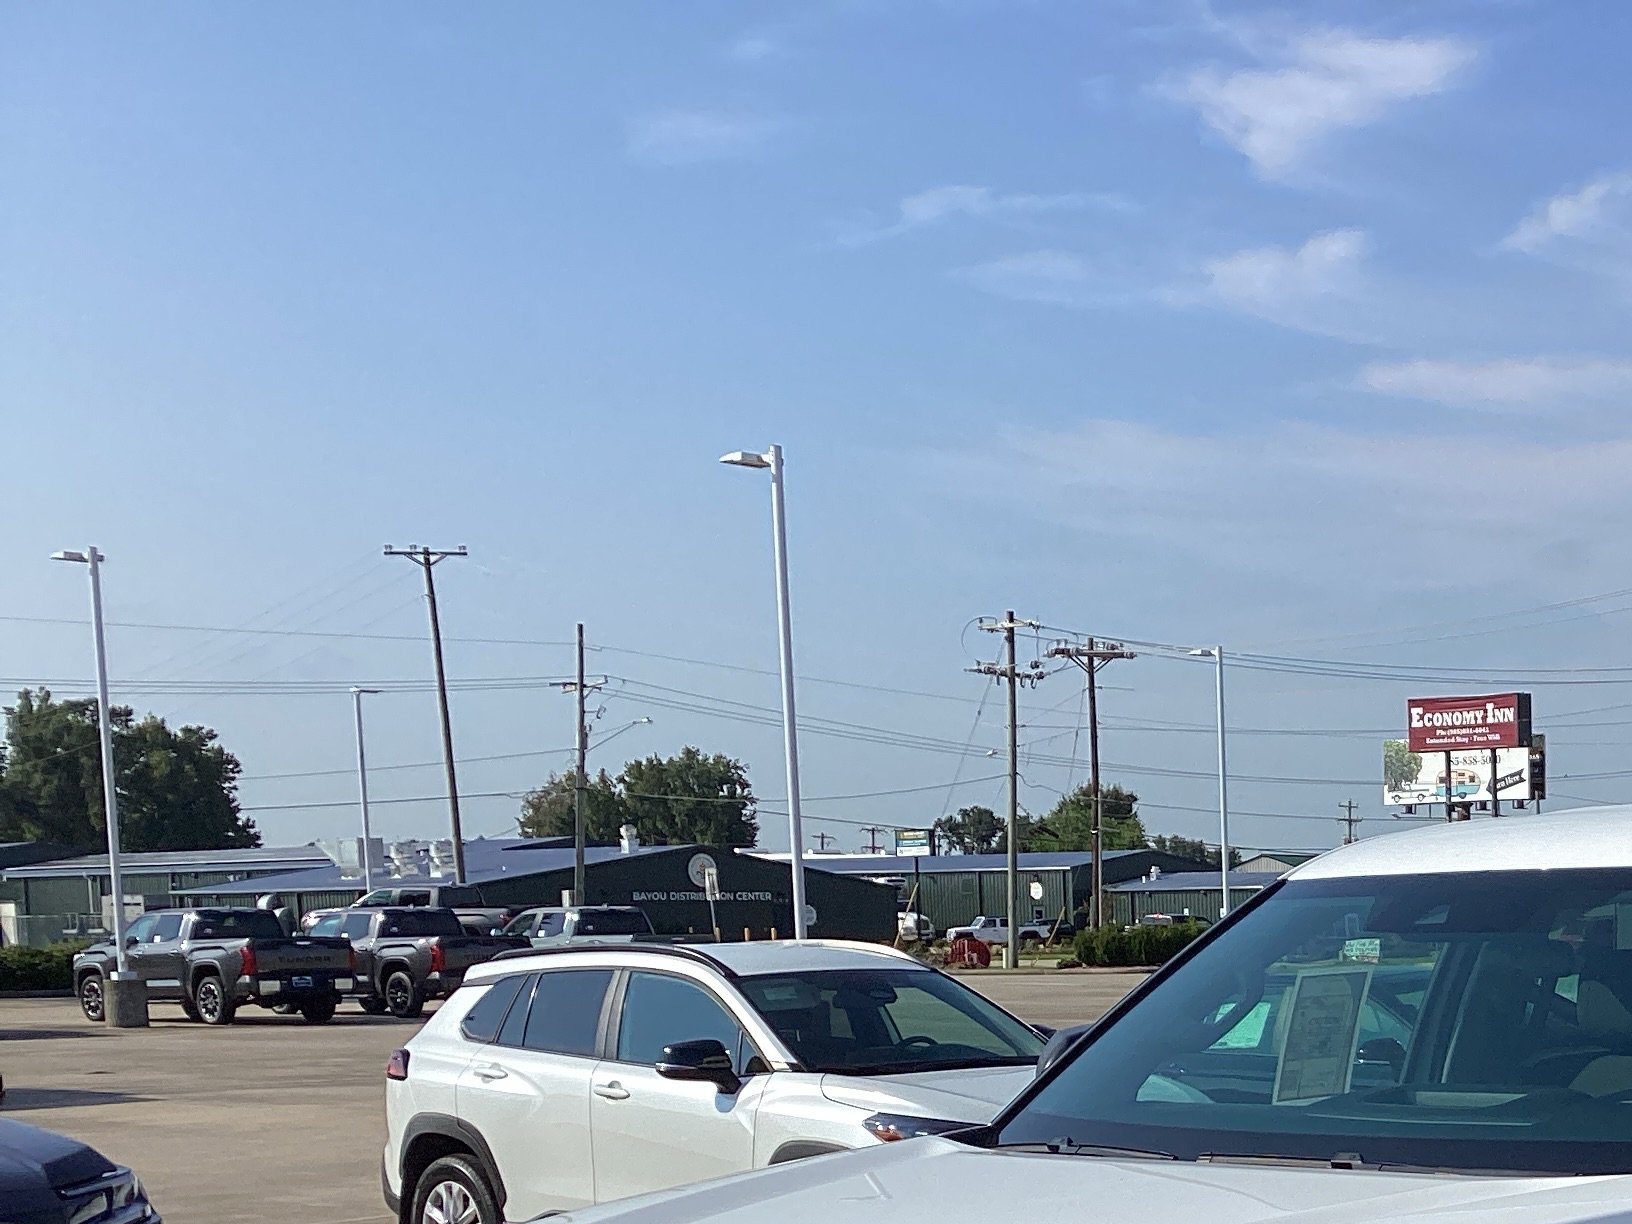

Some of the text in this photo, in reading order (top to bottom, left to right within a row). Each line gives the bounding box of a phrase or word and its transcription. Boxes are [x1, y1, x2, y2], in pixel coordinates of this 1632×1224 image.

[1410, 703, 1514, 728] ECONOMY INN
[632, 891, 772, 902] BAYOU DISTRIBON CENTER
